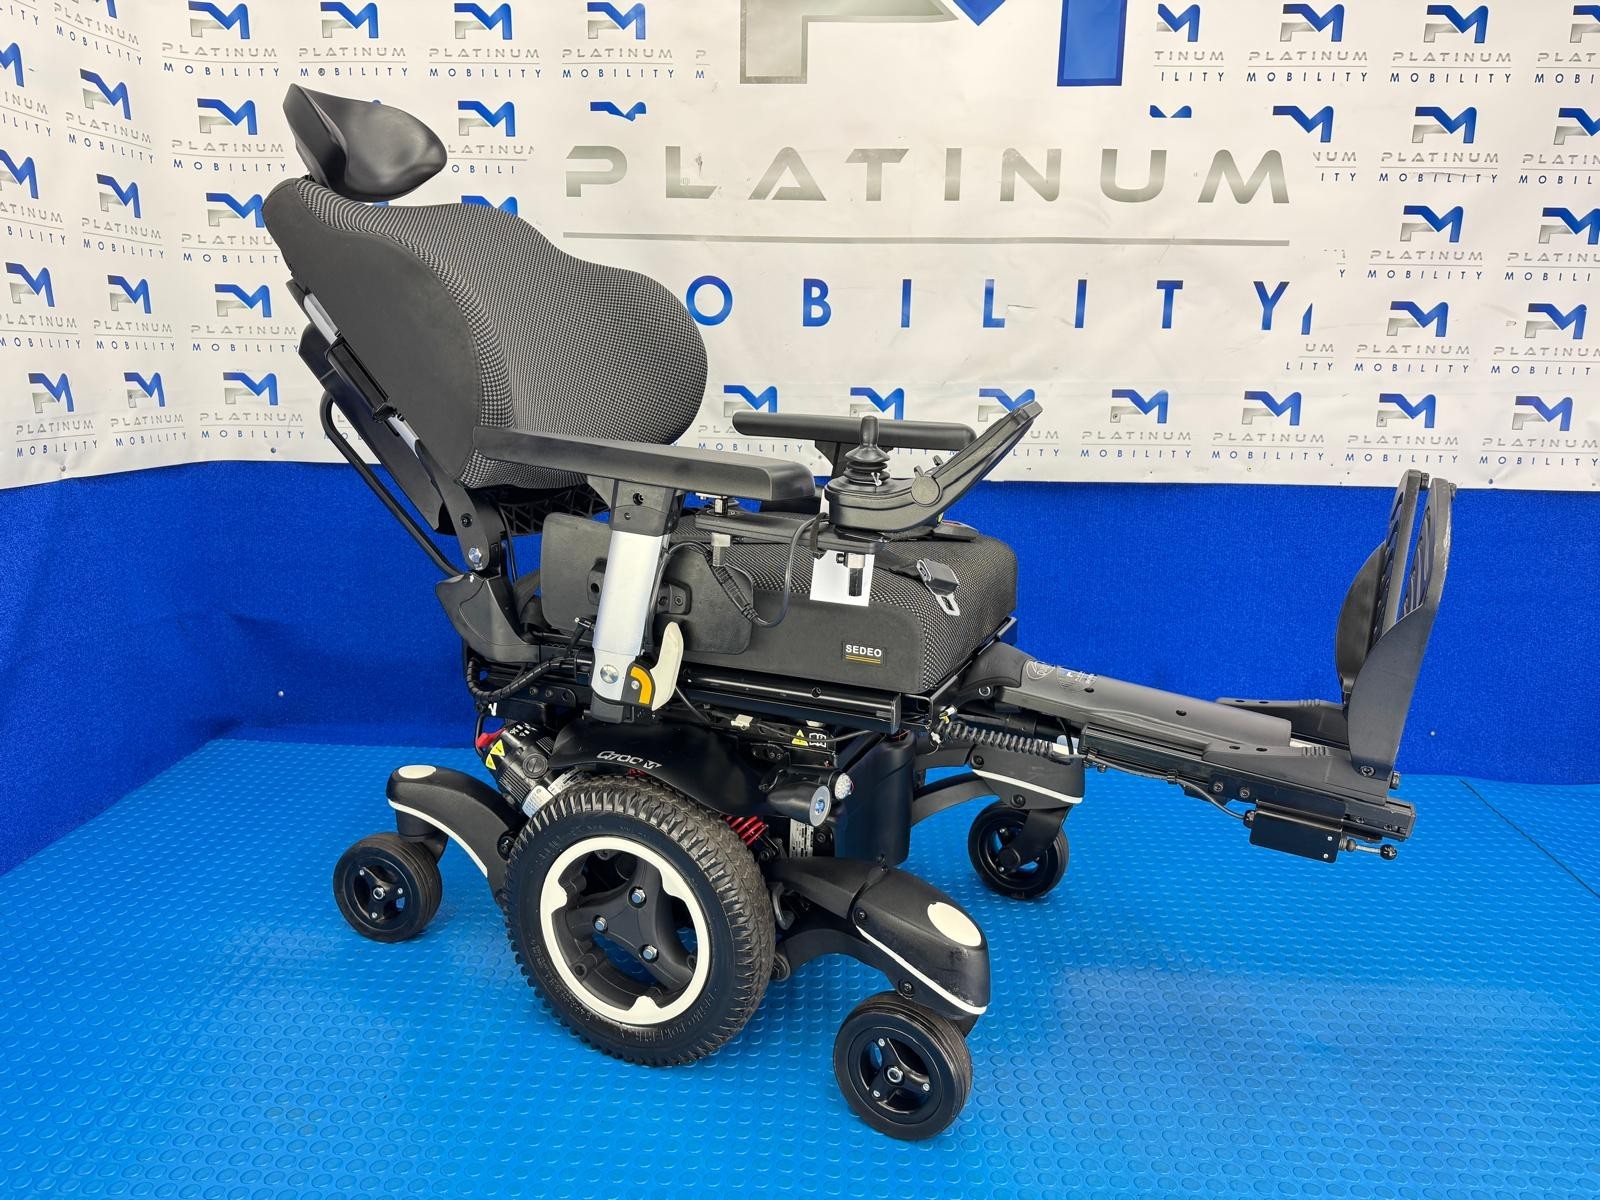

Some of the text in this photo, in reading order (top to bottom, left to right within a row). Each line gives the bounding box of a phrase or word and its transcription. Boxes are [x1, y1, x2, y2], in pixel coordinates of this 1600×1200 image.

[54, 2, 140, 46] PLATINUM
[56, 24, 142, 66] MOBILITY
[162, 42, 278, 58] PLATINUM
[299, 46, 406, 58] PLATINUM
[429, 48, 540, 59] PLATINUM
[562, 48, 673, 59] PLATINUM
[1154, 51, 1225, 61] TINUM
[1248, 51, 1368, 62] PLATINUM
[1392, 52, 1512, 63] PLATINUM
[1537, 53, 1596, 63] PLAT
[164, 62, 280, 78] MOBILITY
[300, 67, 408, 77] MOBILITY
[429, 68, 542, 79] MOBILITY
[562, 68, 675, 79] MOBILITY
[1160, 71, 1225, 83] ILITY
[1246, 71, 1368, 84] MOBILITY
[1390, 72, 1512, 84] MOBILITY
[1534, 74, 1595, 84] MOBI
[4, 91, 48, 115] INUM
[2, 113, 51, 137] ILITY
[66, 112, 152, 144] PLATINUM
[69, 133, 154, 164] MOBILITY
[172, 139, 284, 153] PLATINUM
[1381, 152, 1499, 164] PLATINUM
[1522, 154, 1600, 165] PLATIN
[173, 159, 286, 173] MOBILITY
[452, 165, 514, 174] OBILI
[566, 145, 1290, 205] PLATINUM
[1379, 172, 1498, 184] MOBILITY
[1518, 175, 1592, 185] MOBIL
[82, 217, 162, 240] PLATINUM
[8, 225, 66, 246] BILITY
[181, 233, 273, 245] PLATINU
[83, 239, 165, 259] MOBILITY
[1370, 249, 1483, 261] PLATINUM
[183, 252, 281, 264] MOBILIT
[1367, 269, 1484, 281] MOBILITY
[1505, 272, 1591, 282] MOBILI
[686, 275, 1290, 331] OBILITY
[94, 320, 173, 333] PLATINUM
[191, 324, 297, 336] PLATINUM
[97, 341, 175, 351] MOBILITY
[192, 343, 299, 353] MOBILITY
[1357, 344, 1470, 356] PLATINUM
[1354, 362, 1470, 374] MOBILITY
[1491, 365, 1592, 376] MOBILIT
[110, 414, 184, 428] PLATINUM
[200, 412, 303, 423] PLATINUM
[16, 419, 94, 435] PLATINUM
[115, 433, 187, 447] MOBILITY
[201, 430, 305, 440] MOBILITY
[1082, 431, 1191, 442] PLATINUM
[1213, 434, 1325, 445] PLATINUM
[1348, 435, 1459, 447] PLATINUM
[16, 440, 97, 458] MOBILITY
[699, 442, 803, 453] MOBILITY
[1482, 437, 1598, 449] PLATINUM
[1081, 449, 1191, 460] MOBILITY
[1212, 450, 1324, 462] MOBILITY
[1345, 453, 1458, 465] MOBILITY
[1479, 456, 1599, 467] MOBILITY
[845, 644, 882, 657] SEDEO
